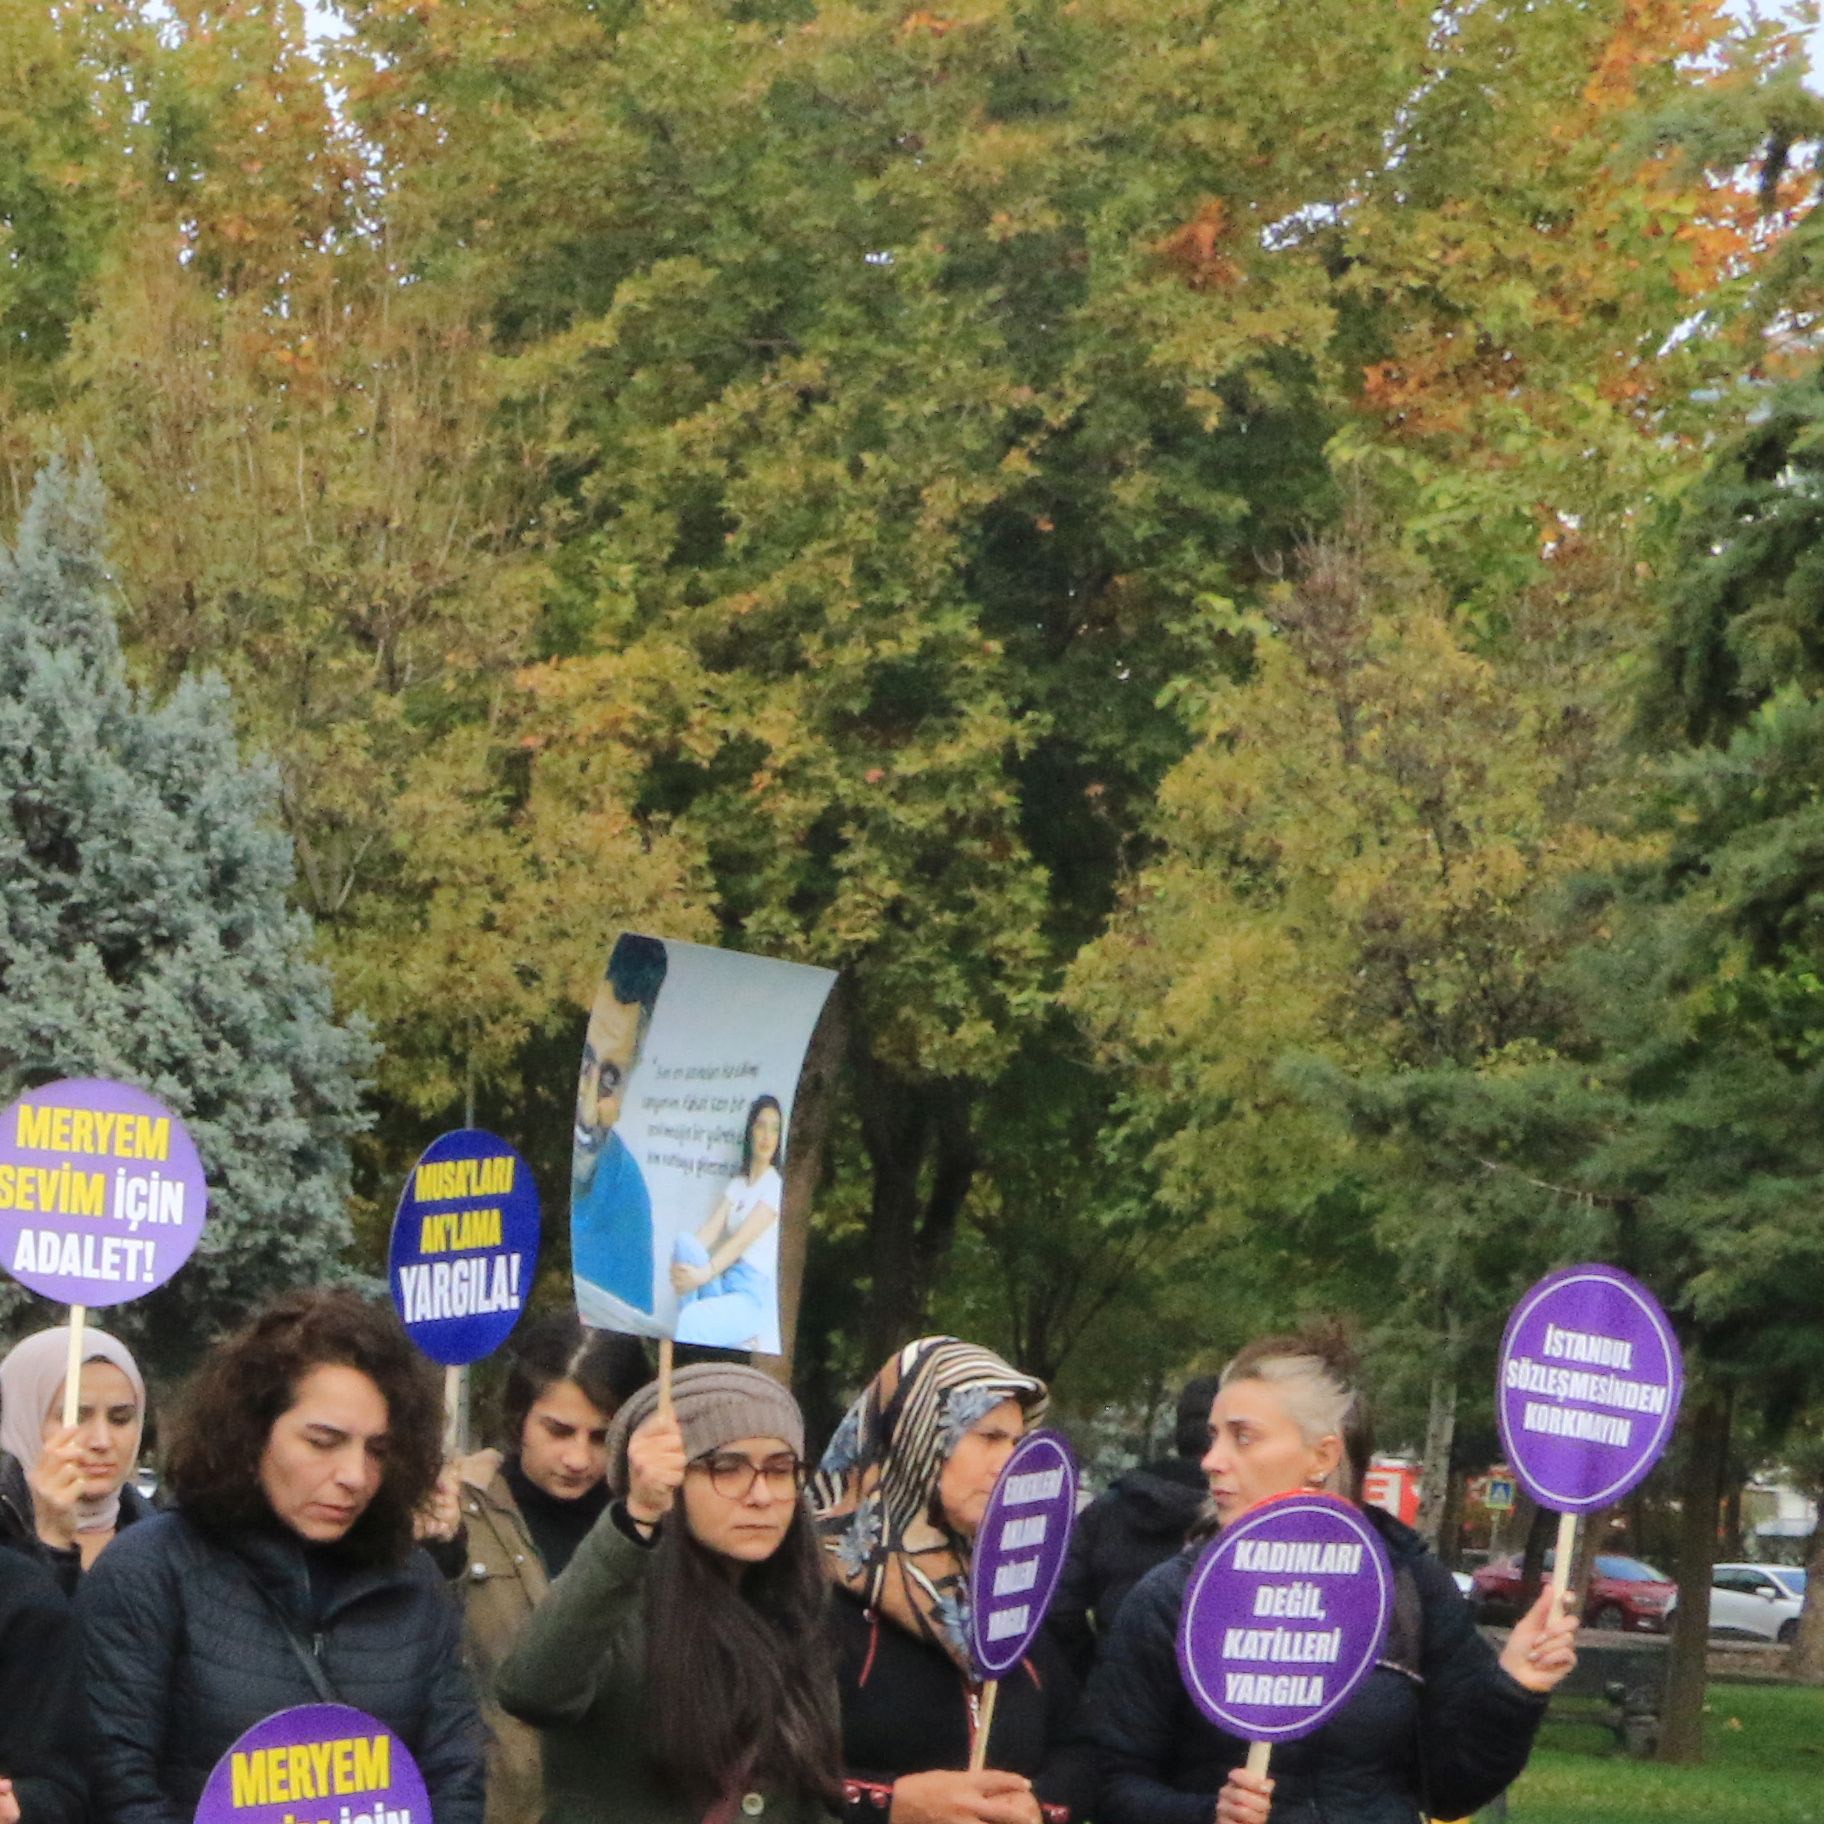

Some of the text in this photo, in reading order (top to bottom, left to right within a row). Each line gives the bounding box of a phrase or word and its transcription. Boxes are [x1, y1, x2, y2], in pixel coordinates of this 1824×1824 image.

[16, 1103, 170, 1162] MERYEM
[113, 1167, 184, 1232] İÇİN
[13, 1229, 156, 1283] ADALET!
[399, 1253, 521, 1324] YARGILA!
[1543, 1322, 1633, 1371] İSTANBUL
[1506, 1356, 1667, 1415] SÖZLEŞMESİNDEN
[1233, 1539, 1363, 1575] KADINLARI
[1253, 1581, 1327, 1621] DEĞİL,
[1222, 1626, 1342, 1663] KATİLLERİ
[1225, 1672, 1324, 1707] YARGILA
[231, 1735, 391, 1808] MERYEM
